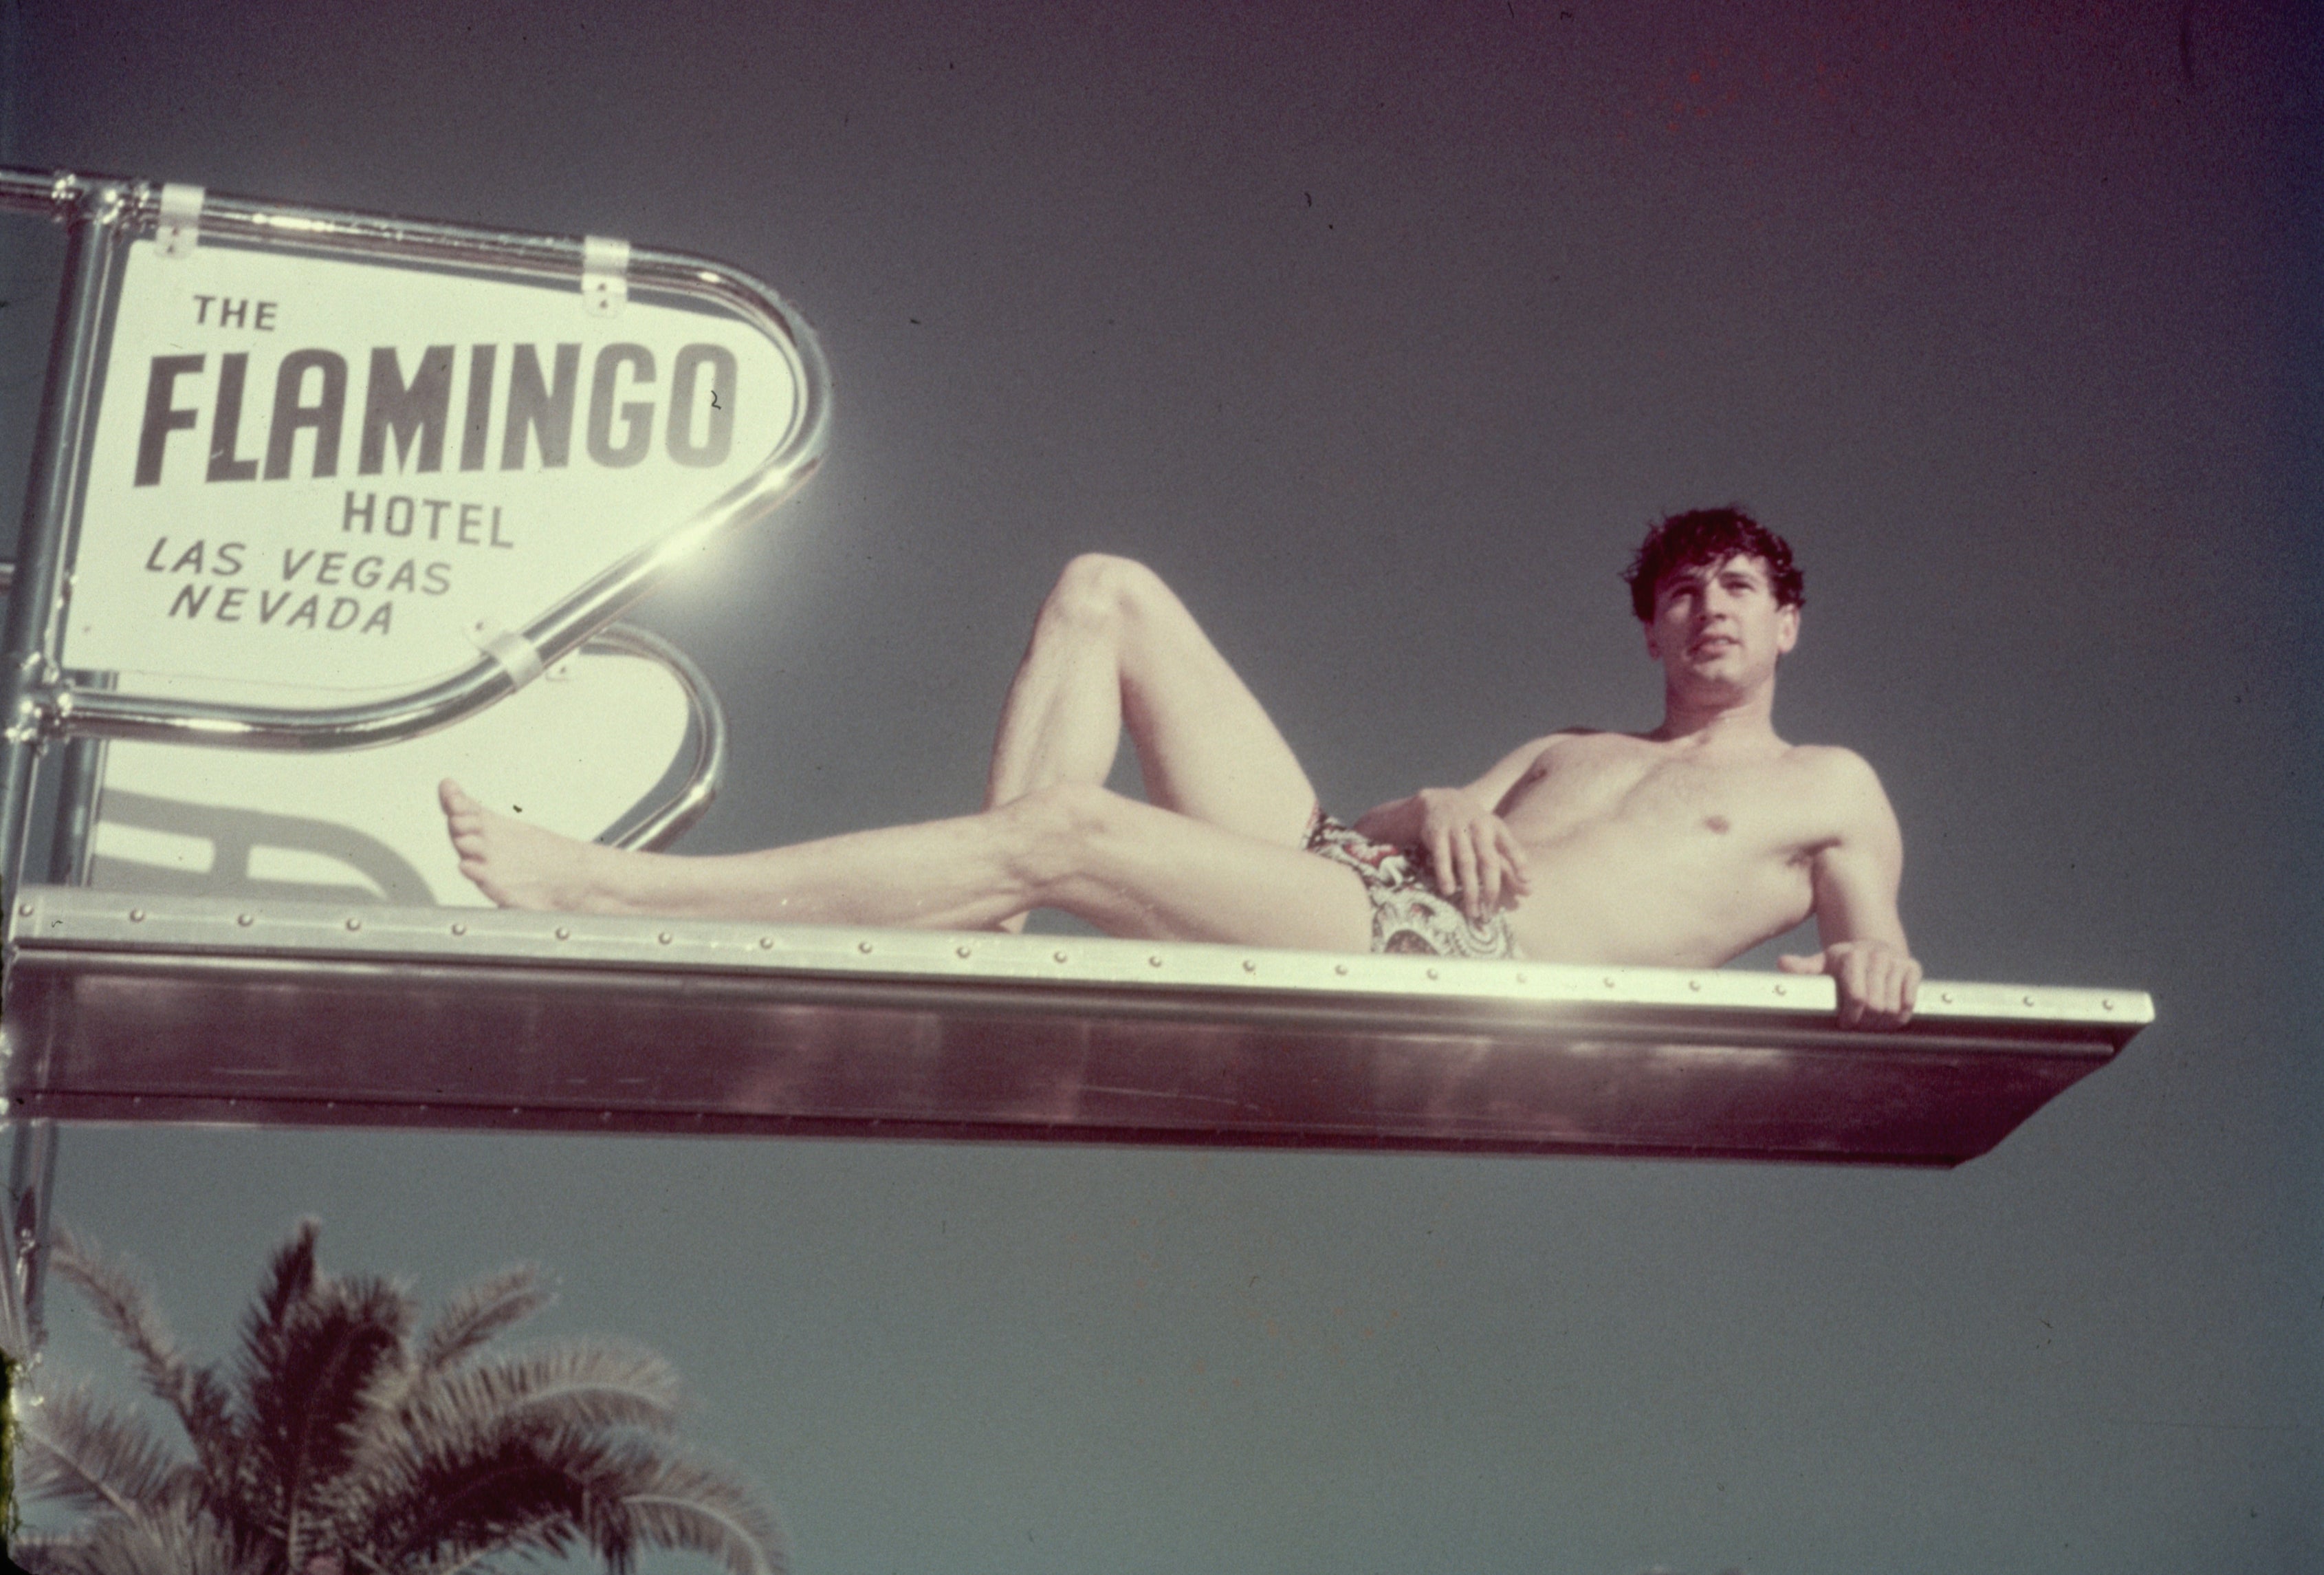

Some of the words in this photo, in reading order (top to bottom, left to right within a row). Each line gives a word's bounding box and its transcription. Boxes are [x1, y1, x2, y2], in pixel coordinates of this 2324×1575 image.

[193, 294, 278, 333] THE
[132, 341, 738, 489] FLAMINGO
[341, 490, 514, 550] HOTEL
[144, 536, 247, 577] LAS
[282, 547, 451, 596] VEGAS
[167, 583, 393, 636] NEVADA
